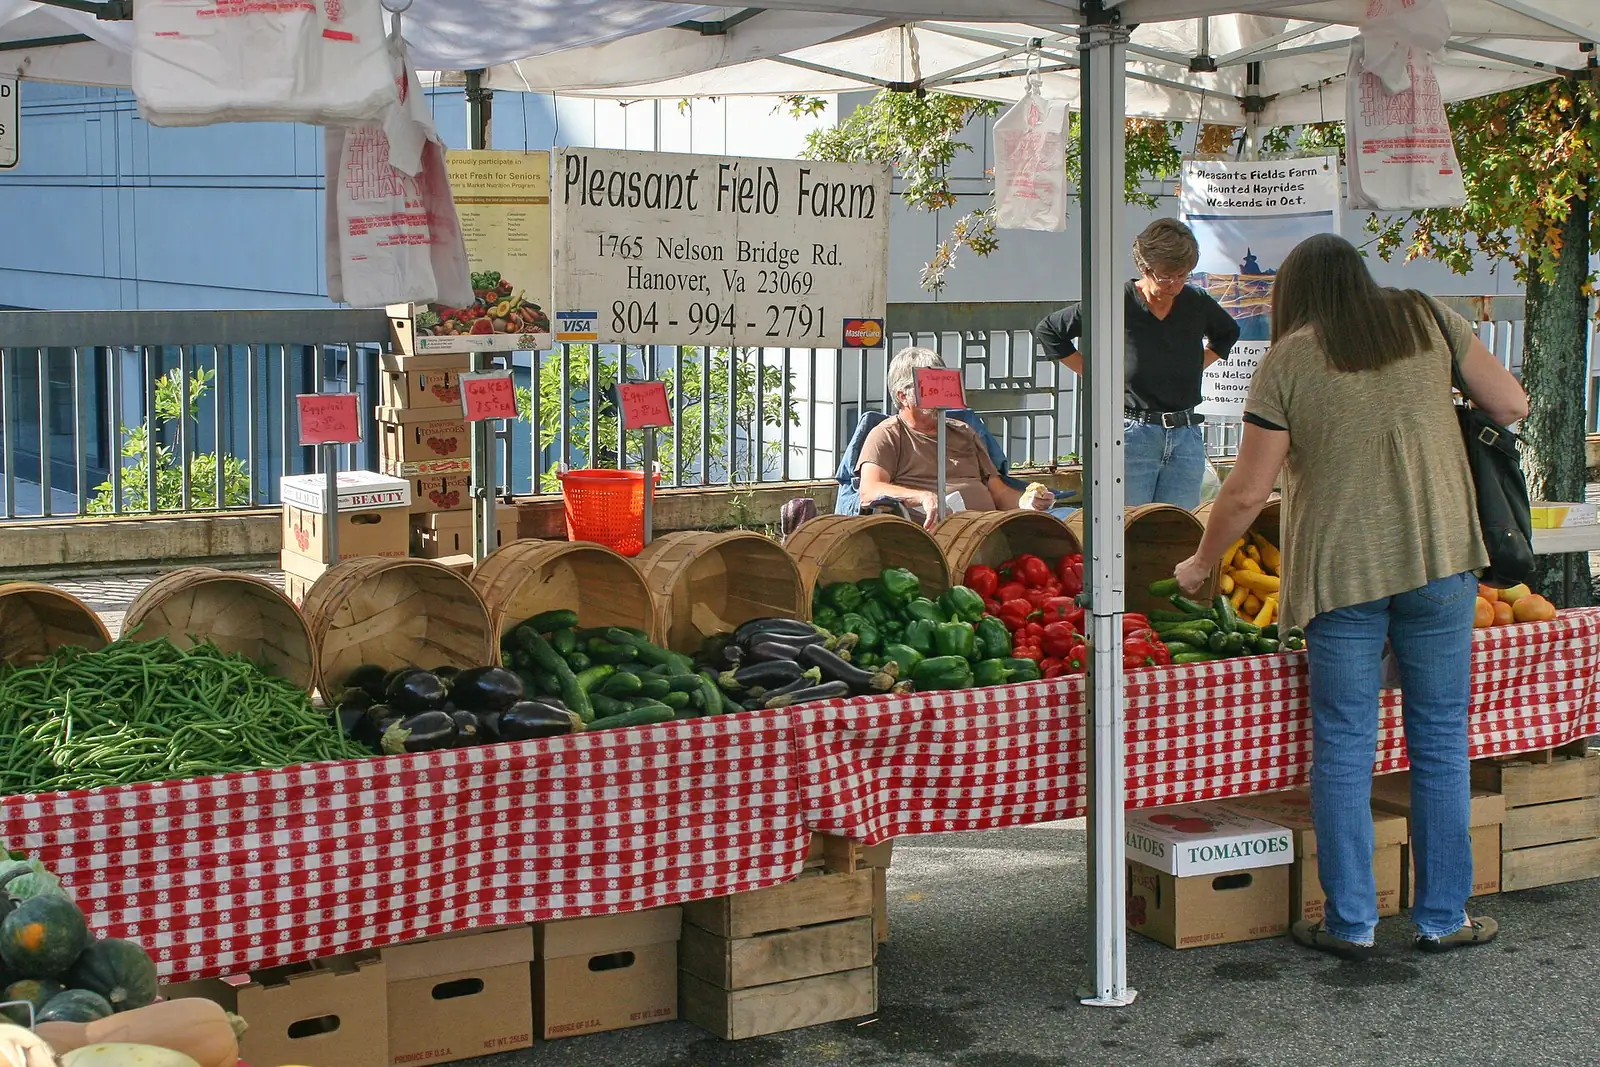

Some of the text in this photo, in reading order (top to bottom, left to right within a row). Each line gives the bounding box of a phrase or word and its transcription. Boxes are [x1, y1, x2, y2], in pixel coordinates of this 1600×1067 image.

[451, 158, 477, 166] proudly
[478, 158, 514, 166] participate
[447, 172, 541, 180] arket Fresh for Seniors
[1197, 168, 1317, 180] Pleasants Fields Farm
[564, 154, 876, 220] Pleasant Field Farm
[1207, 183, 1305, 195] Haunted Hayrides
[1206, 196, 1306, 207] Weekends in Oct.
[598, 234, 843, 269] 1765 Nelson Bridge Rd.
[627, 265, 813, 297] Hanover, Va 23069
[611, 300, 659, 334] 804
[688, 302, 737, 337] 994
[765, 304, 826, 338] 2791
[563, 320, 592, 332] VISA
[1229, 347, 1240, 355] all
[1243, 347, 1260, 355] for
[1217, 358, 1258, 367] and Info
[1204, 371, 1252, 379] 765 Nelso
[1214, 382, 1250, 392] Hanove
[351, 491, 404, 506] BEAUTY
[1188, 836, 1289, 863] TOMATOES
[575, 1021, 584, 1029] OF
[394, 1053, 424, 1064] PRODUCE
[425, 1051, 433, 1059] OF
[484, 1039, 496, 1048] NET
